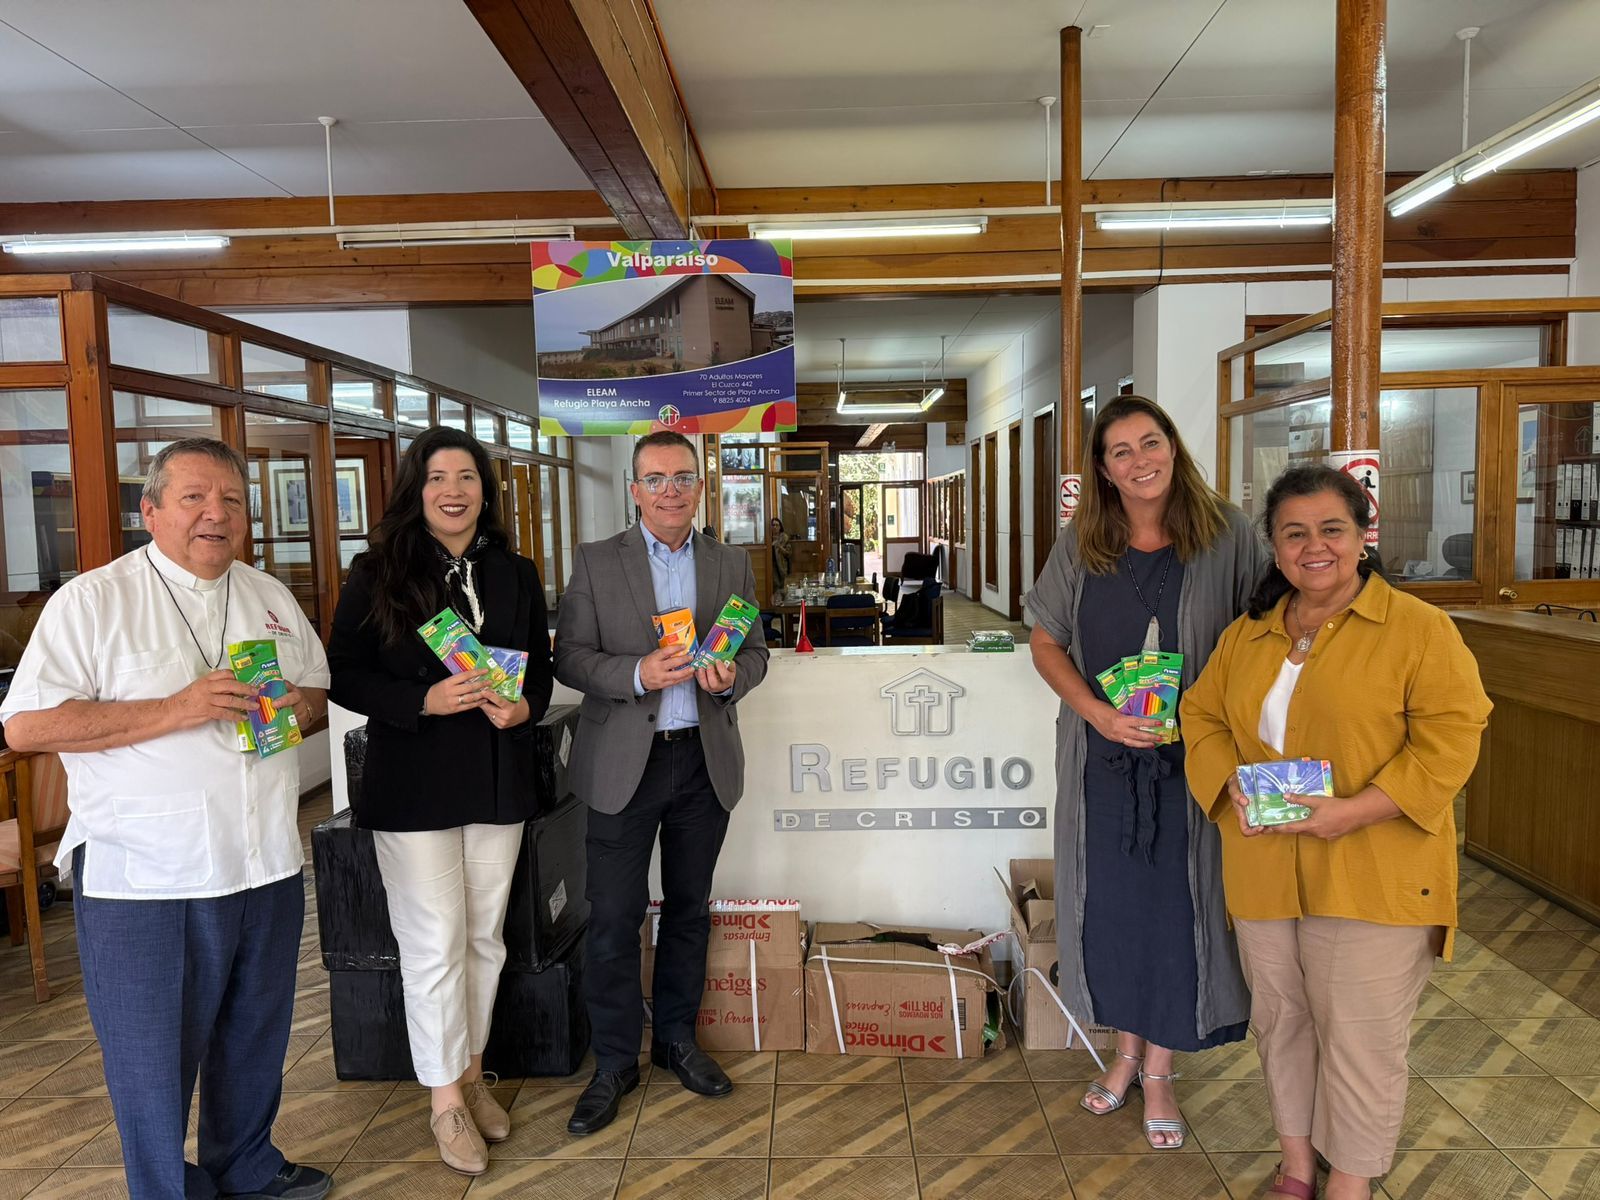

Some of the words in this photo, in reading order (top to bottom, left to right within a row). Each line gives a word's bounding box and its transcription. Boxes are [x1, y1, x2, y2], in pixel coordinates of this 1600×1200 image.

[606, 251, 719, 270] Valparaíso
[586, 388, 617, 397] ELEAM
[737, 388, 756, 397] Playa
[553, 399, 589, 410] Refugio
[591, 399, 617, 409] Playa
[620, 398, 651, 407] Ancha
[790, 743, 1033, 793] REFUGIO
[781, 811, 831, 829] DE
[856, 809, 1041, 828] CRISTO
[712, 914, 756, 931] Dime
[723, 932, 771, 942] Empresas
[922, 1001, 943, 1012] POR
[845, 1021, 879, 1033] Office
